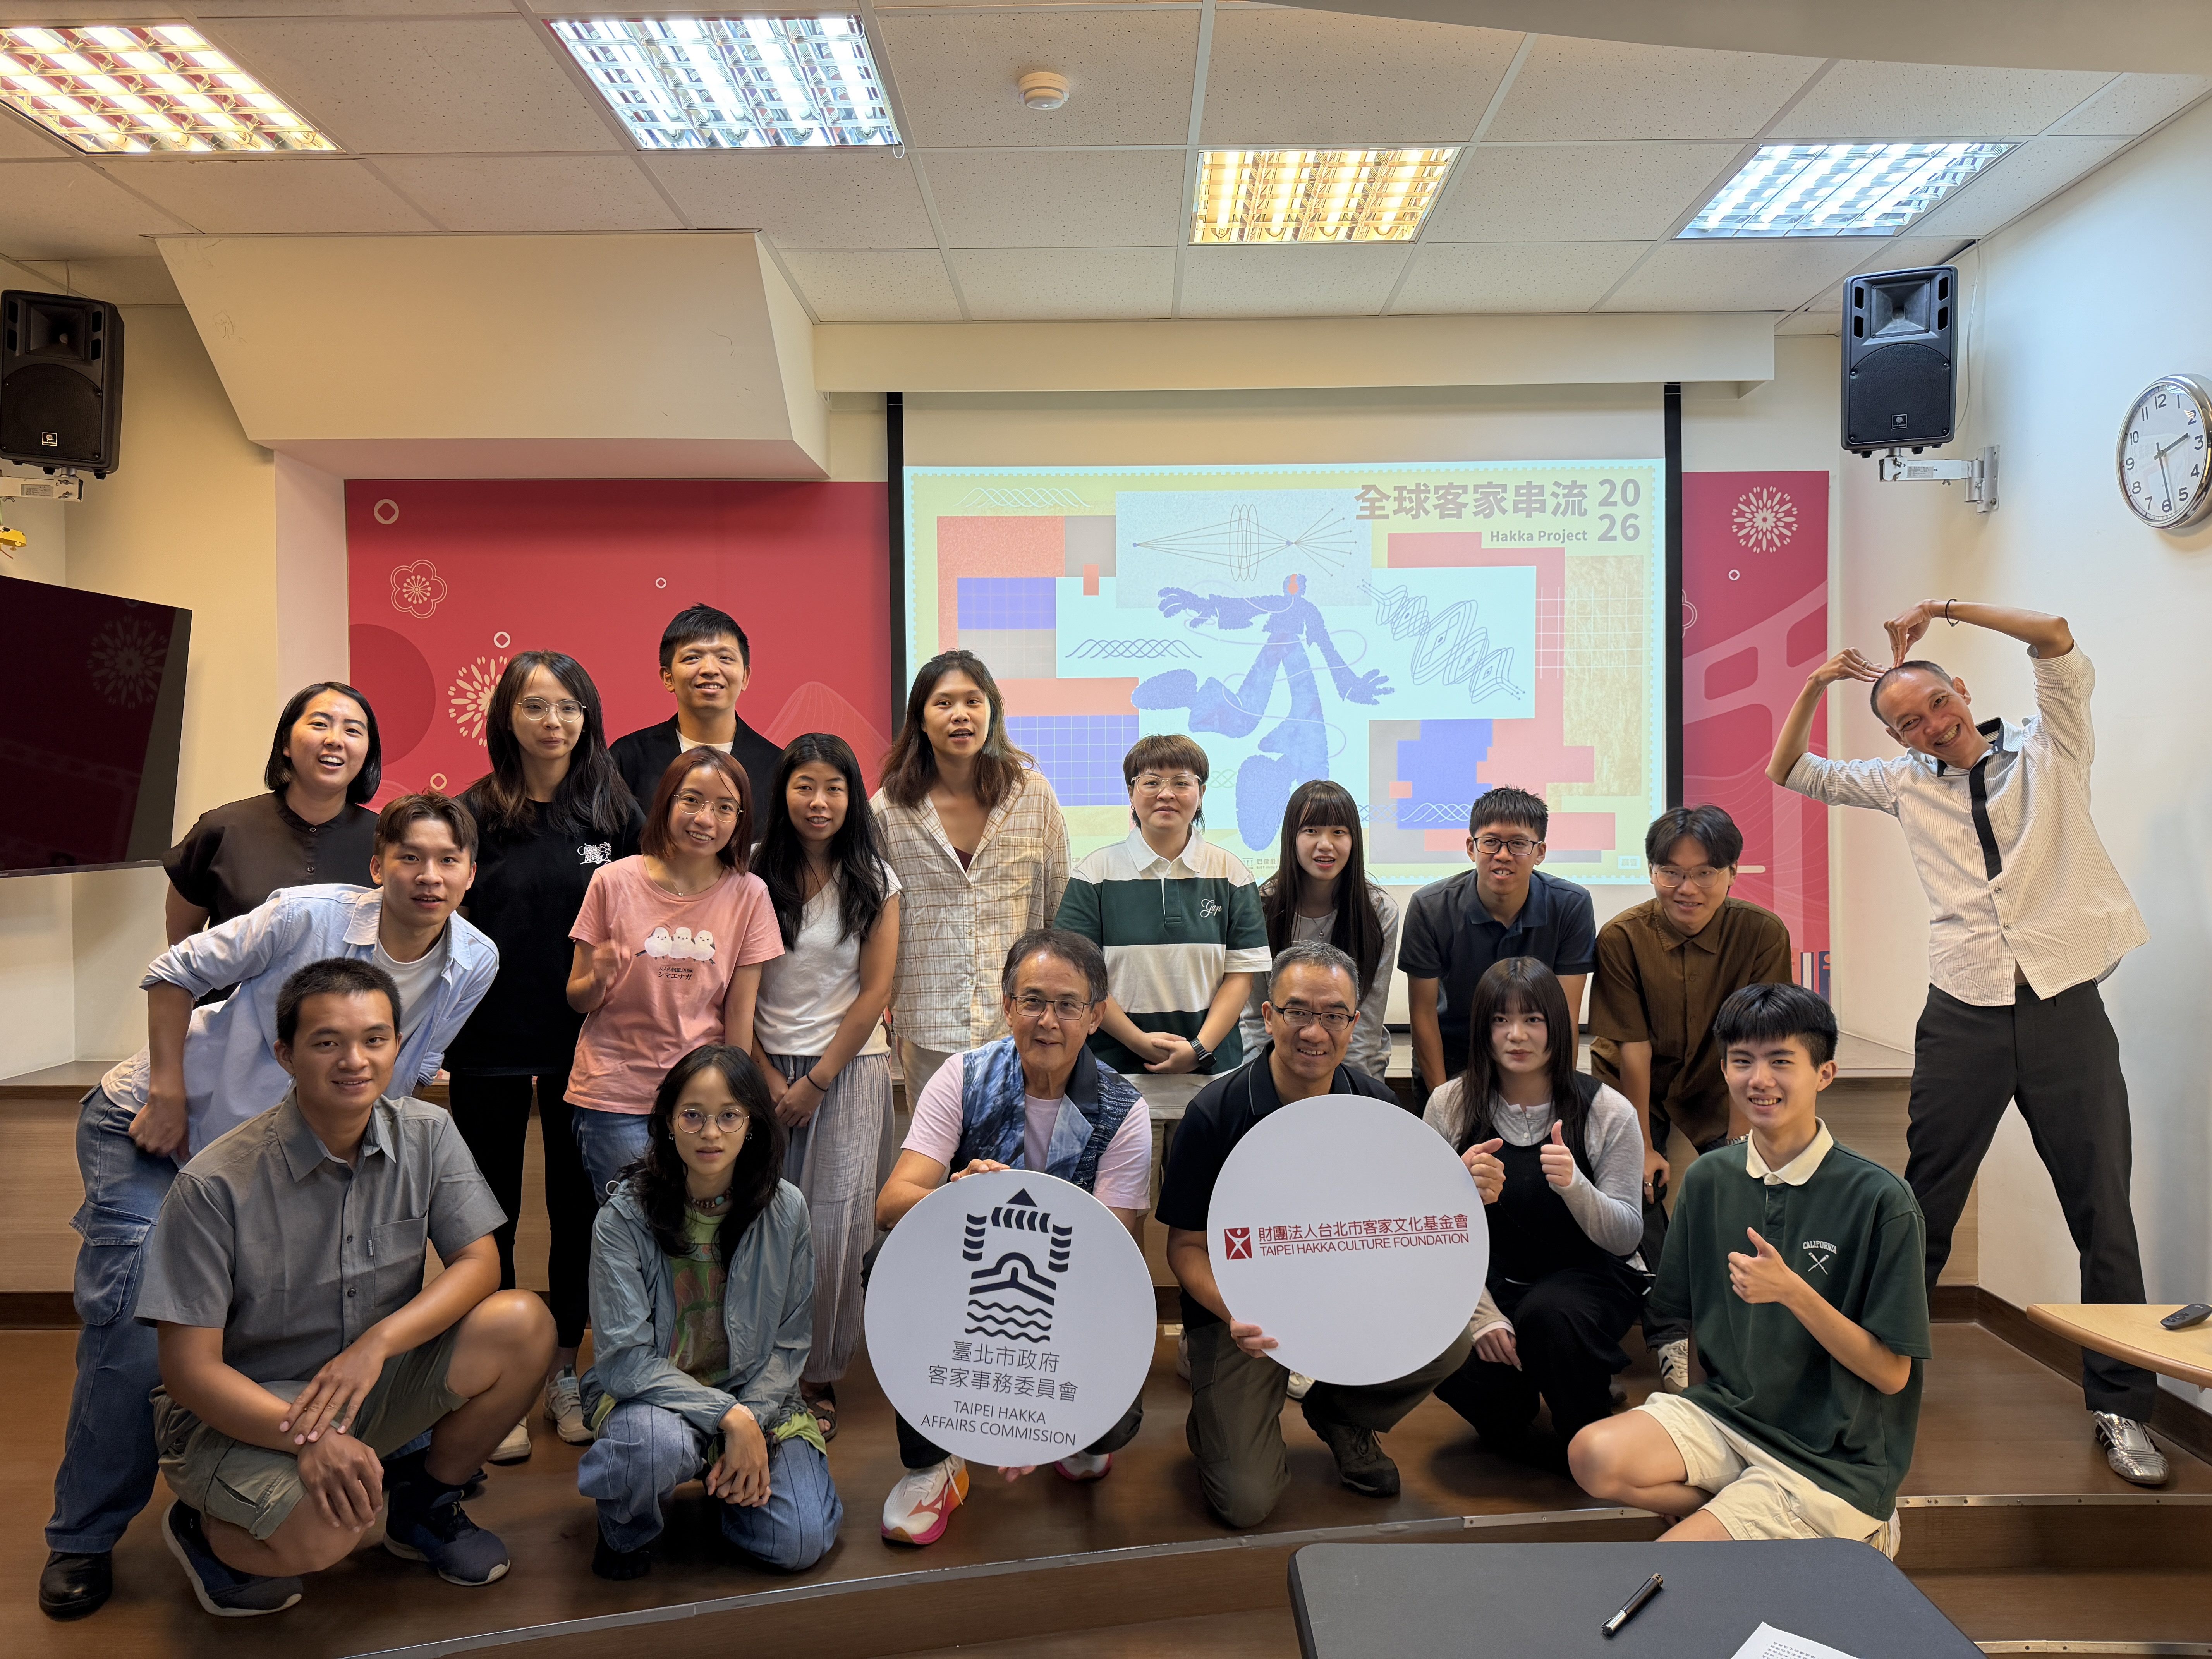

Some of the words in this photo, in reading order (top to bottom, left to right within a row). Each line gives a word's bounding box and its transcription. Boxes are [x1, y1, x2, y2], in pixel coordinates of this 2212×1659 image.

[2155, 394, 2167, 409] 12
[2177, 395, 2180, 408] 1
[2142, 407, 2148, 421] 11
[2187, 410, 2197, 425] 2
[2130, 431, 2138, 445] 10
[2194, 435, 2203, 450] 3
[2126, 457, 2134, 470] 9
[2191, 464, 2200, 477] 4
[1598, 479, 1641, 507] 20
[2132, 481, 2141, 494] 8
[2179, 487, 2188, 501] 5
[1354, 481, 1588, 520] 全球客家串流
[2145, 496, 2152, 510] 7
[2162, 499, 2171, 513] 6
[1597, 513, 1640, 541] 26
[1490, 530, 1533, 542] Hakka
[1538, 529, 1588, 543] Project
[1200, 899, 1222, 917] Gap
[658, 972, 692, 980] シマエナガ
[1258, 1214, 1468, 1242] 財團法人台北市客家文化基金會
[1260, 1244, 1294, 1256] TAIPEI
[1297, 1242, 1336, 1254] HAKKA
[1338, 1238, 1391, 1251] CULTURE
[1394, 1233, 1469, 1247] FOUNDATION
[952, 1341, 1059, 1373] 臺北市政府
[928, 1365, 1078, 1402] 客家事務委員會
[954, 1401, 993, 1417] TAIPEI
[999, 1407, 1046, 1424] HAKKA
[921, 1414, 976, 1432] AFFAIRS
[980, 1422, 1075, 1446] COMMISSION
